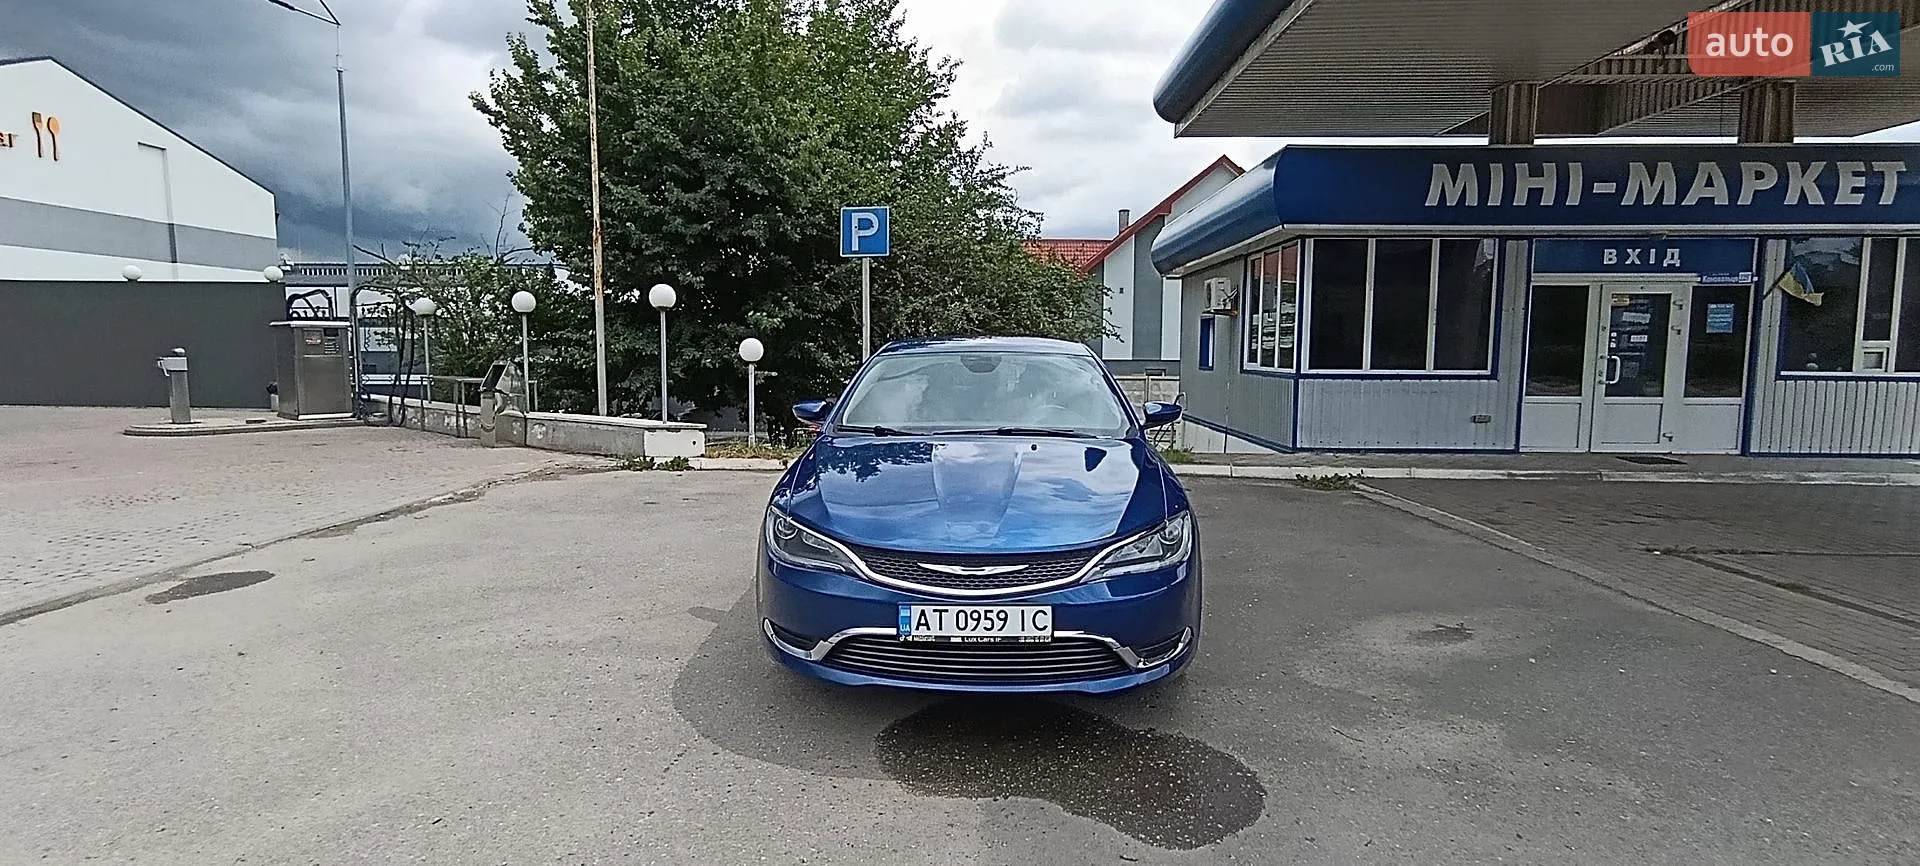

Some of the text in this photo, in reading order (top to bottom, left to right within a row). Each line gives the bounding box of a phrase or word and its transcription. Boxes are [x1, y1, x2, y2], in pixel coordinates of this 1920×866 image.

[1425, 161, 1907, 206] МІНІ-МАРКЕТ
[851, 212, 879, 251] P
[1603, 248, 1681, 267] ВХІД
[900, 623, 911, 633] UA
[914, 608, 1049, 632] AT 0959 IC
